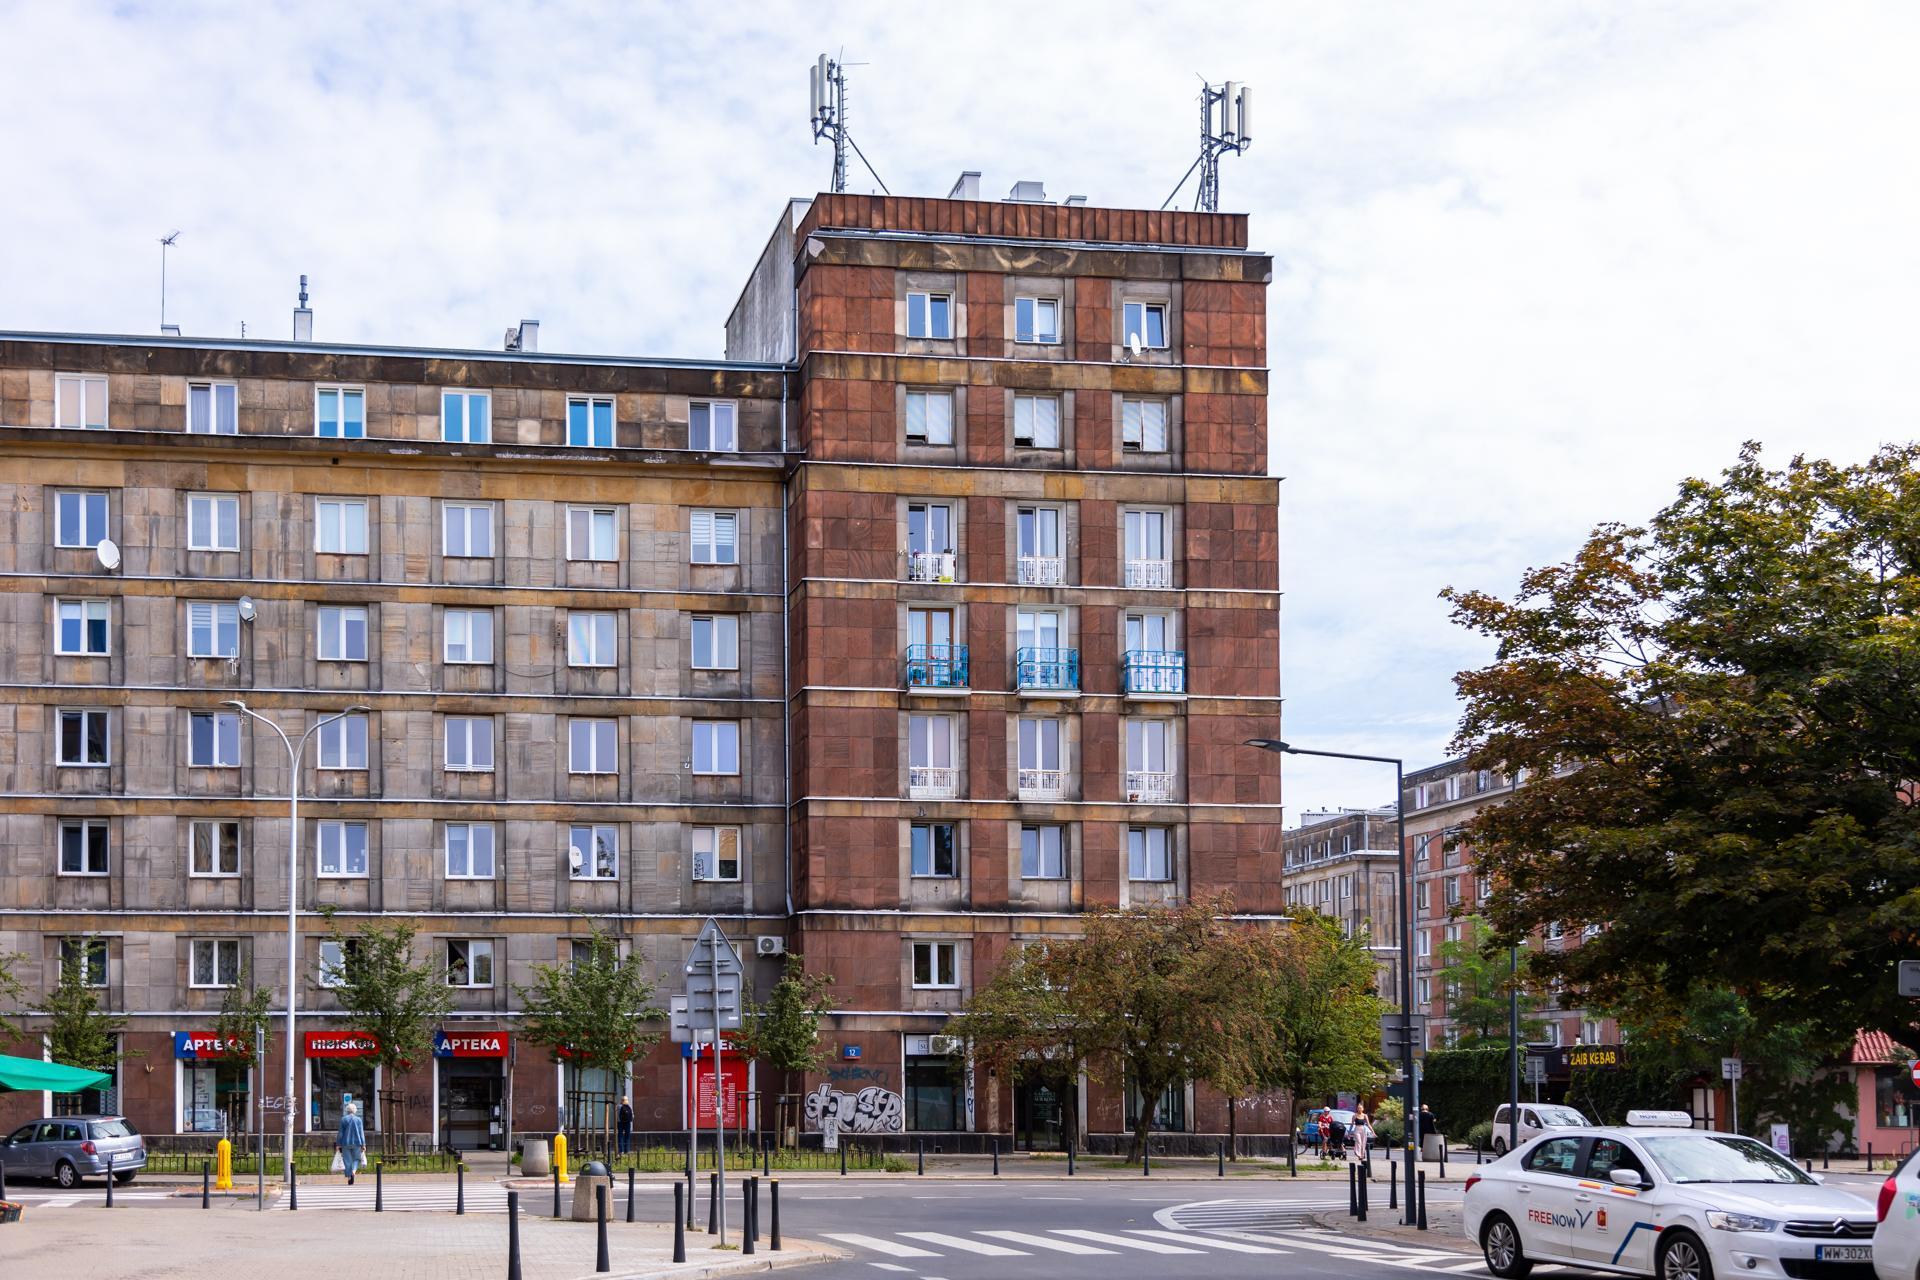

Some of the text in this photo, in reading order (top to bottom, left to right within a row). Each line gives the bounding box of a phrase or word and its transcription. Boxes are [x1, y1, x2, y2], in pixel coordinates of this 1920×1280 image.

[440, 1039, 501, 1051] APTEKA
[849, 1049, 856, 1057] 12
[1570, 1053, 1588, 1066] ZAIB
[1589, 1051, 1616, 1065] KEBAB
[1528, 1209, 1576, 1229] FREENOW
[1824, 1247, 1841, 1259] WW
